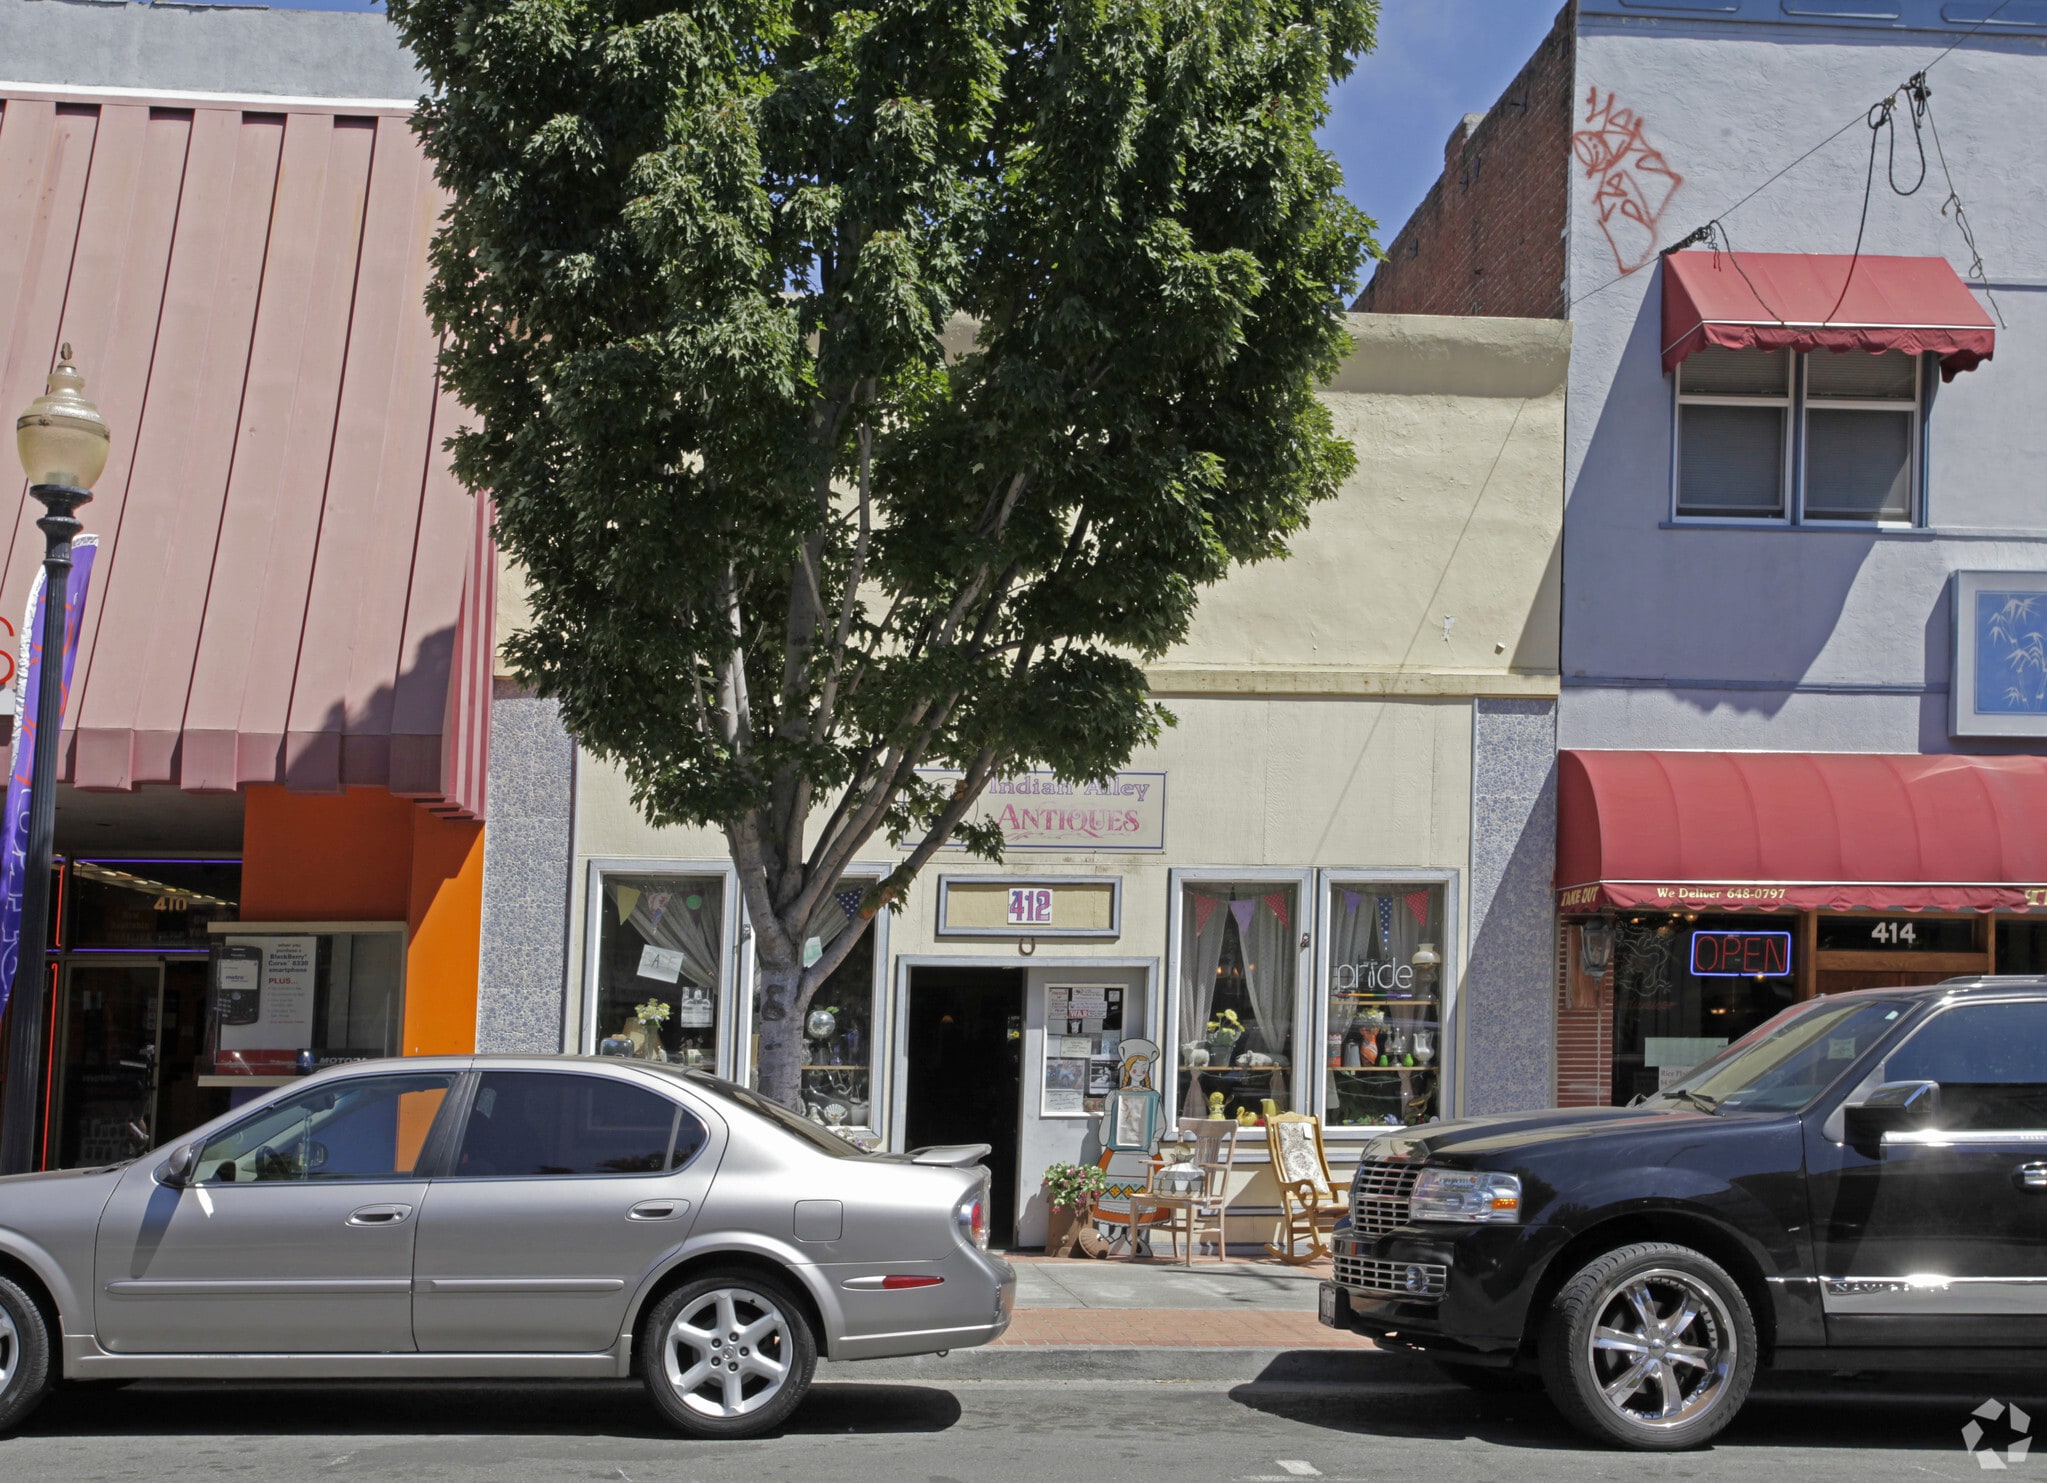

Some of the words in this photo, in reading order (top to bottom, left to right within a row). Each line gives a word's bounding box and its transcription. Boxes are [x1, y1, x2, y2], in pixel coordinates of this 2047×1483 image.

[989, 777, 1073, 796] Indian
[1084, 778, 1150, 802] Alley
[999, 803, 1140, 838] ANTIQUES
[153, 896, 188, 911] 410
[1560, 889, 1581, 906] TAKE
[1581, 886, 1600, 903] OUT
[1656, 887, 1675, 898] We
[1678, 887, 1722, 898] Deliver
[1726, 888, 1786, 899] 648-0797
[1009, 890, 1051, 922] 412
[1871, 921, 1917, 944] 414
[1694, 935, 1787, 972] OPEN
[1337, 956, 1413, 992] pride
